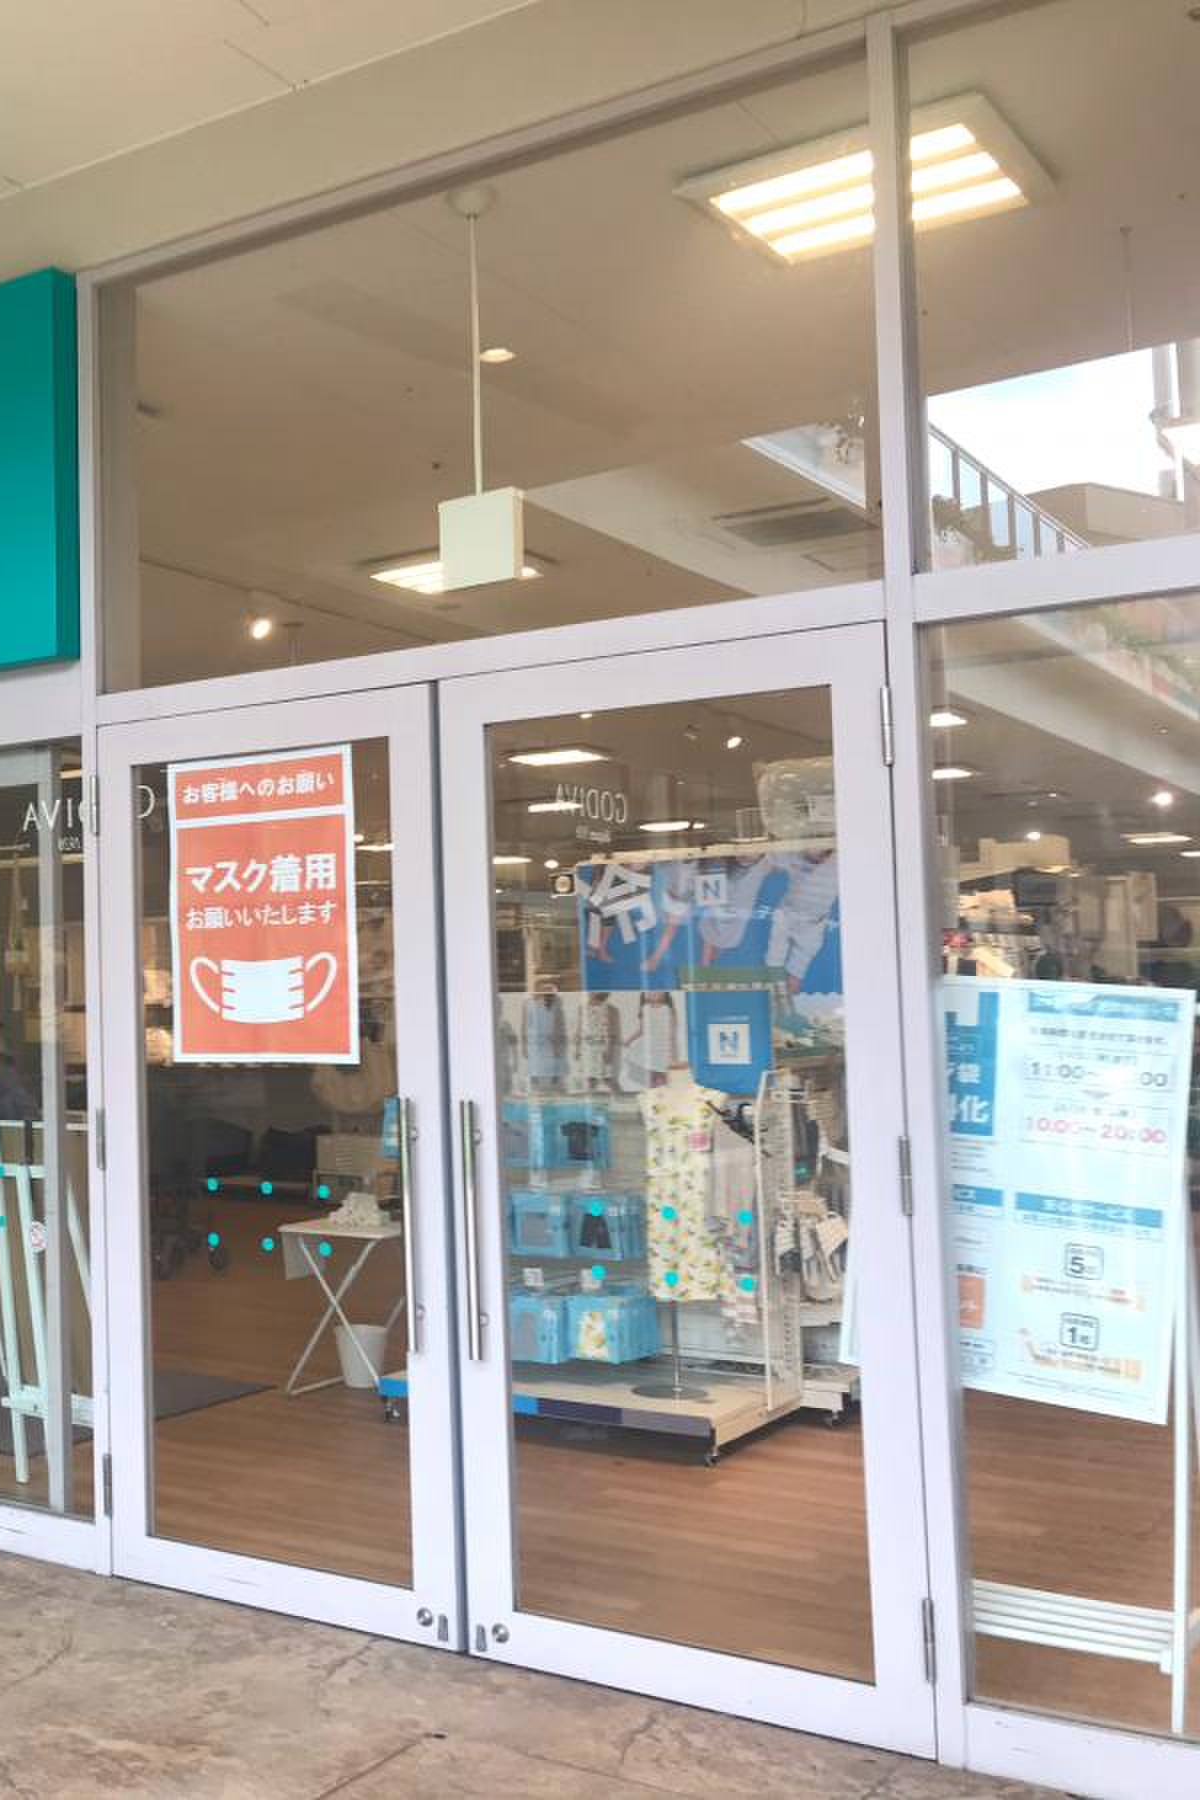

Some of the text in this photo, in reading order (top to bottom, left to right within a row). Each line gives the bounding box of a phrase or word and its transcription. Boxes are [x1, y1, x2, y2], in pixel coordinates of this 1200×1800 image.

[183, 771, 335, 804] お客様へのお願い
[185, 851, 337, 894] マスク着用
[186, 900, 337, 931] お願いいたします
